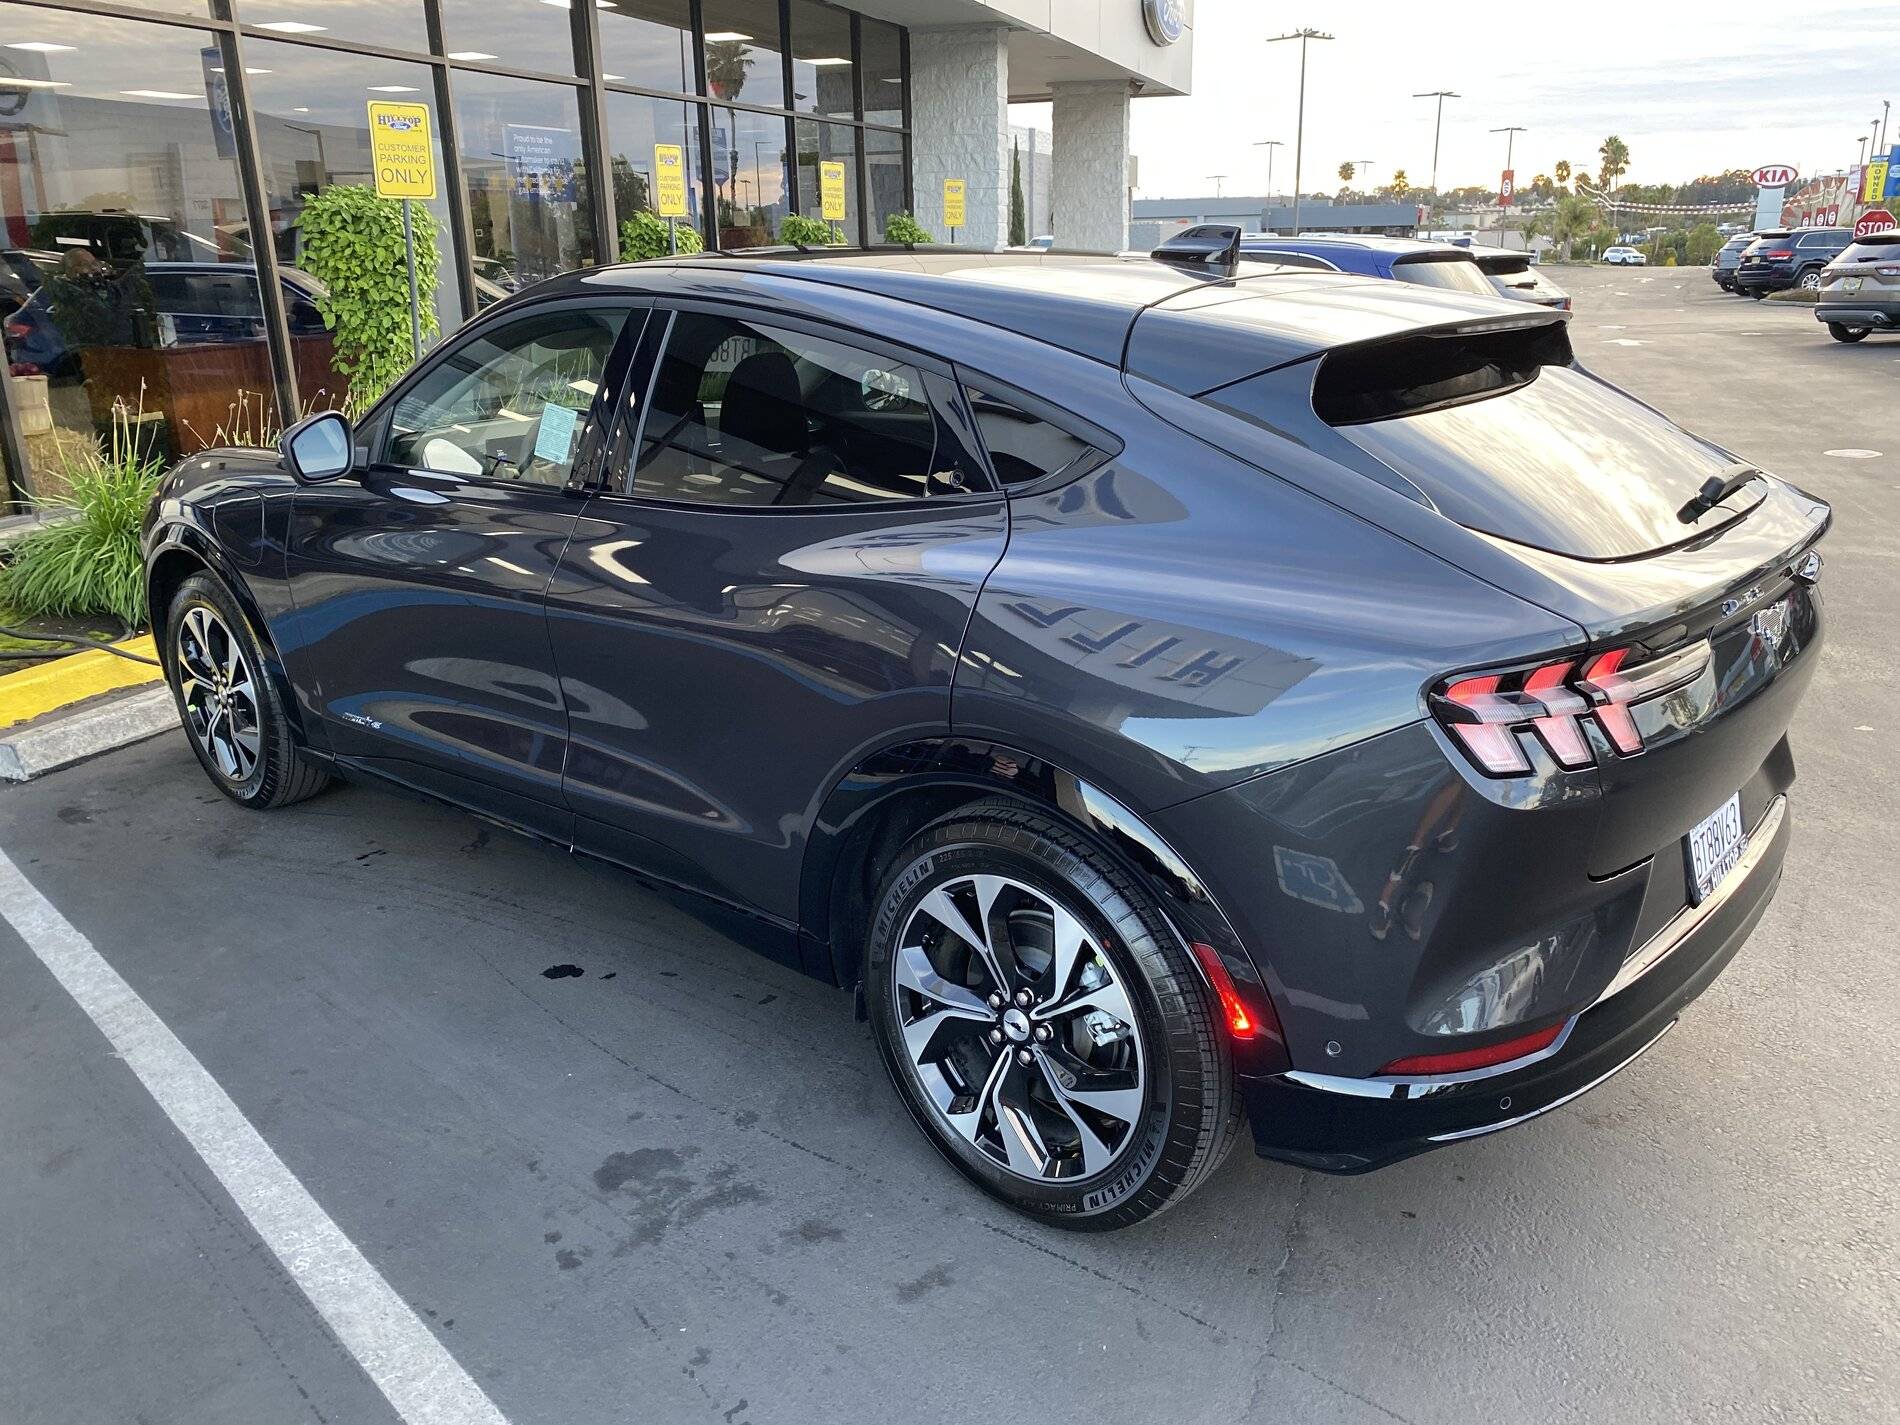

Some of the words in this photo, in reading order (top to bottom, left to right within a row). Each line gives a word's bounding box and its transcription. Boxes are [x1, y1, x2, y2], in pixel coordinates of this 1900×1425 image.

[378, 114, 422, 127] HILLTOP
[378, 143, 426, 153] CUSTOMER
[513, 144, 526, 154] only
[380, 153, 426, 165] PARKING
[381, 167, 428, 184] ONLY
[1758, 169, 1790, 183] KIA
[1871, 168, 1882, 200] OWNED
[661, 193, 682, 206] ONLY
[824, 200, 843, 211] ONLY
[1857, 221, 1893, 236] STOP
[1693, 802, 1737, 880] BT88V63
[879, 860, 931, 938] MICHELIN
[1088, 1138, 1156, 1209] MICHELIN
